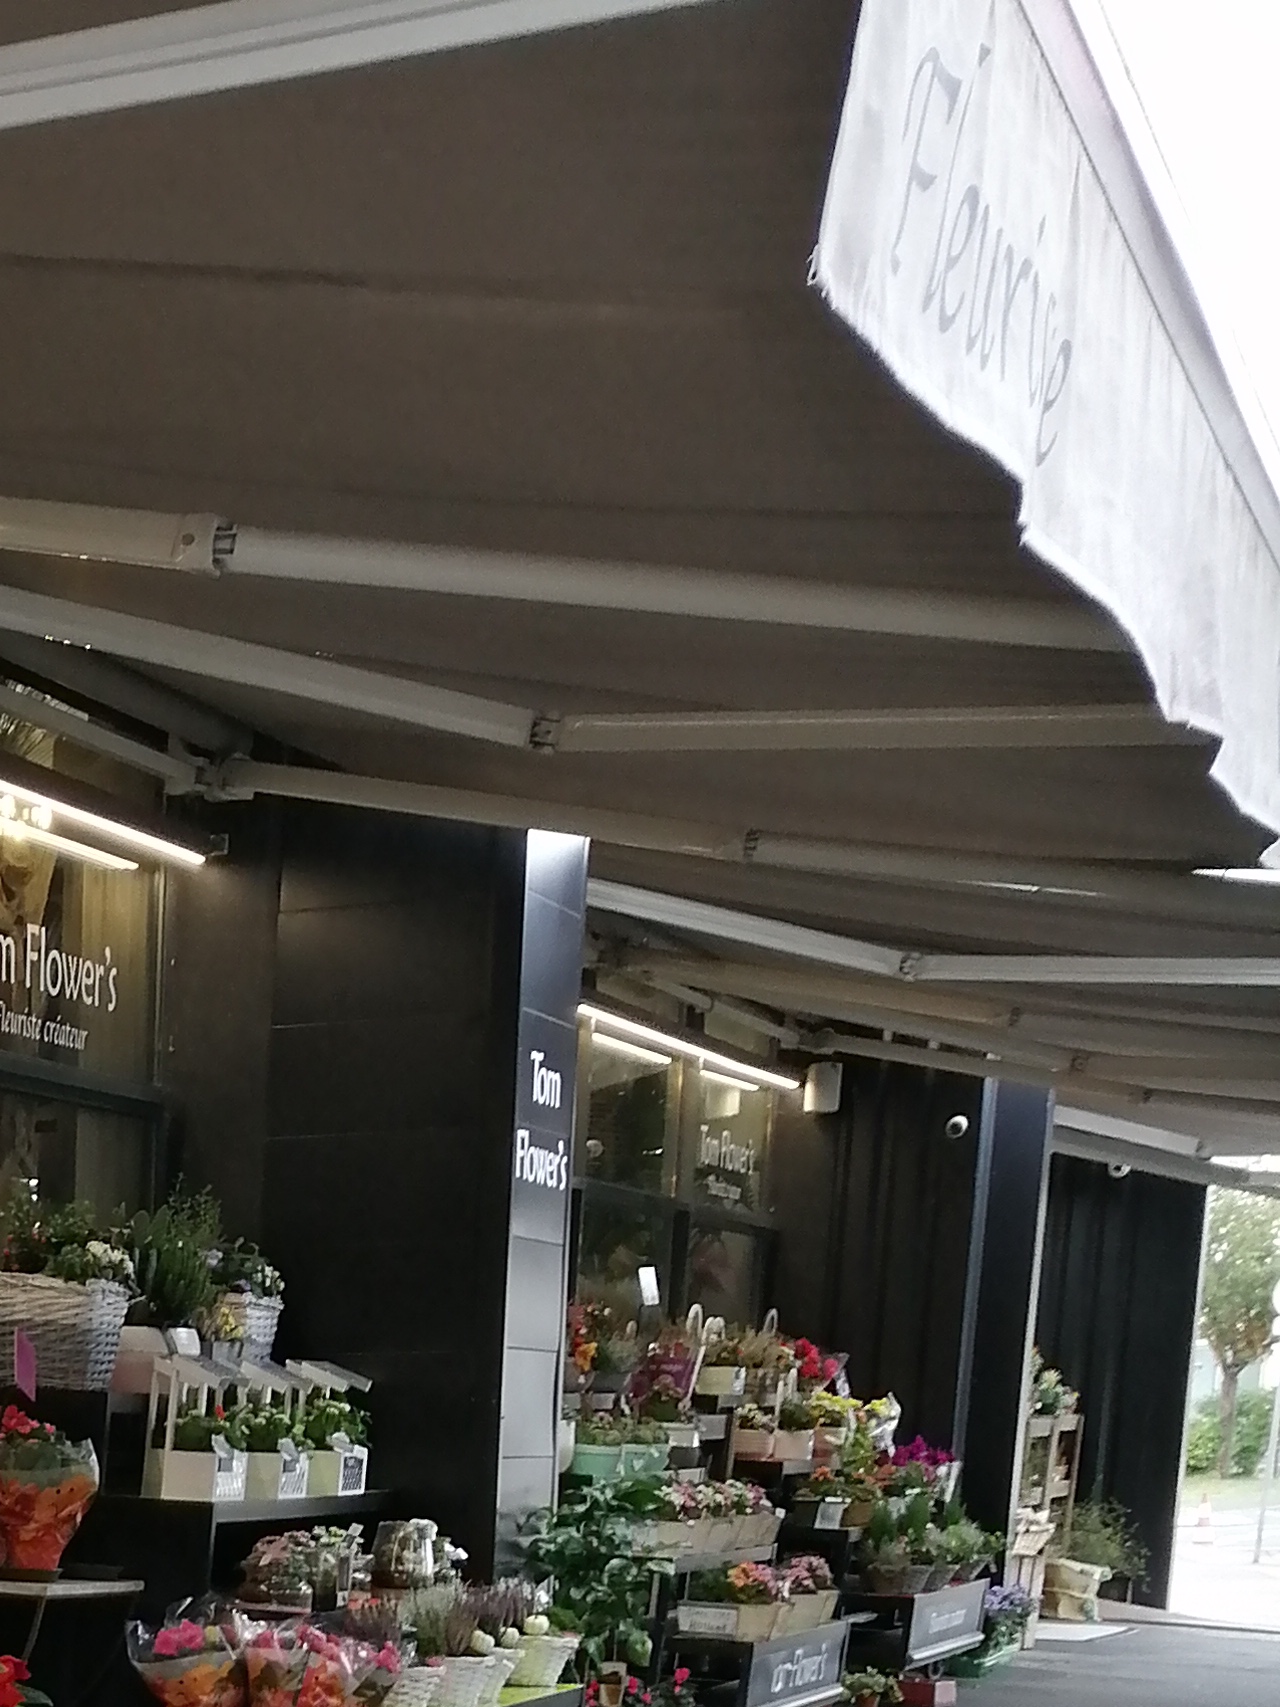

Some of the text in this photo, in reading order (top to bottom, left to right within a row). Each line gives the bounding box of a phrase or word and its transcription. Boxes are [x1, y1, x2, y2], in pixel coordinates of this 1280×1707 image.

[25, 922, 118, 1012] Flower's
[43, 1015, 89, 1050] créateur
[530, 1050, 561, 1109] Tom
[515, 1128, 568, 1191] Flower's
